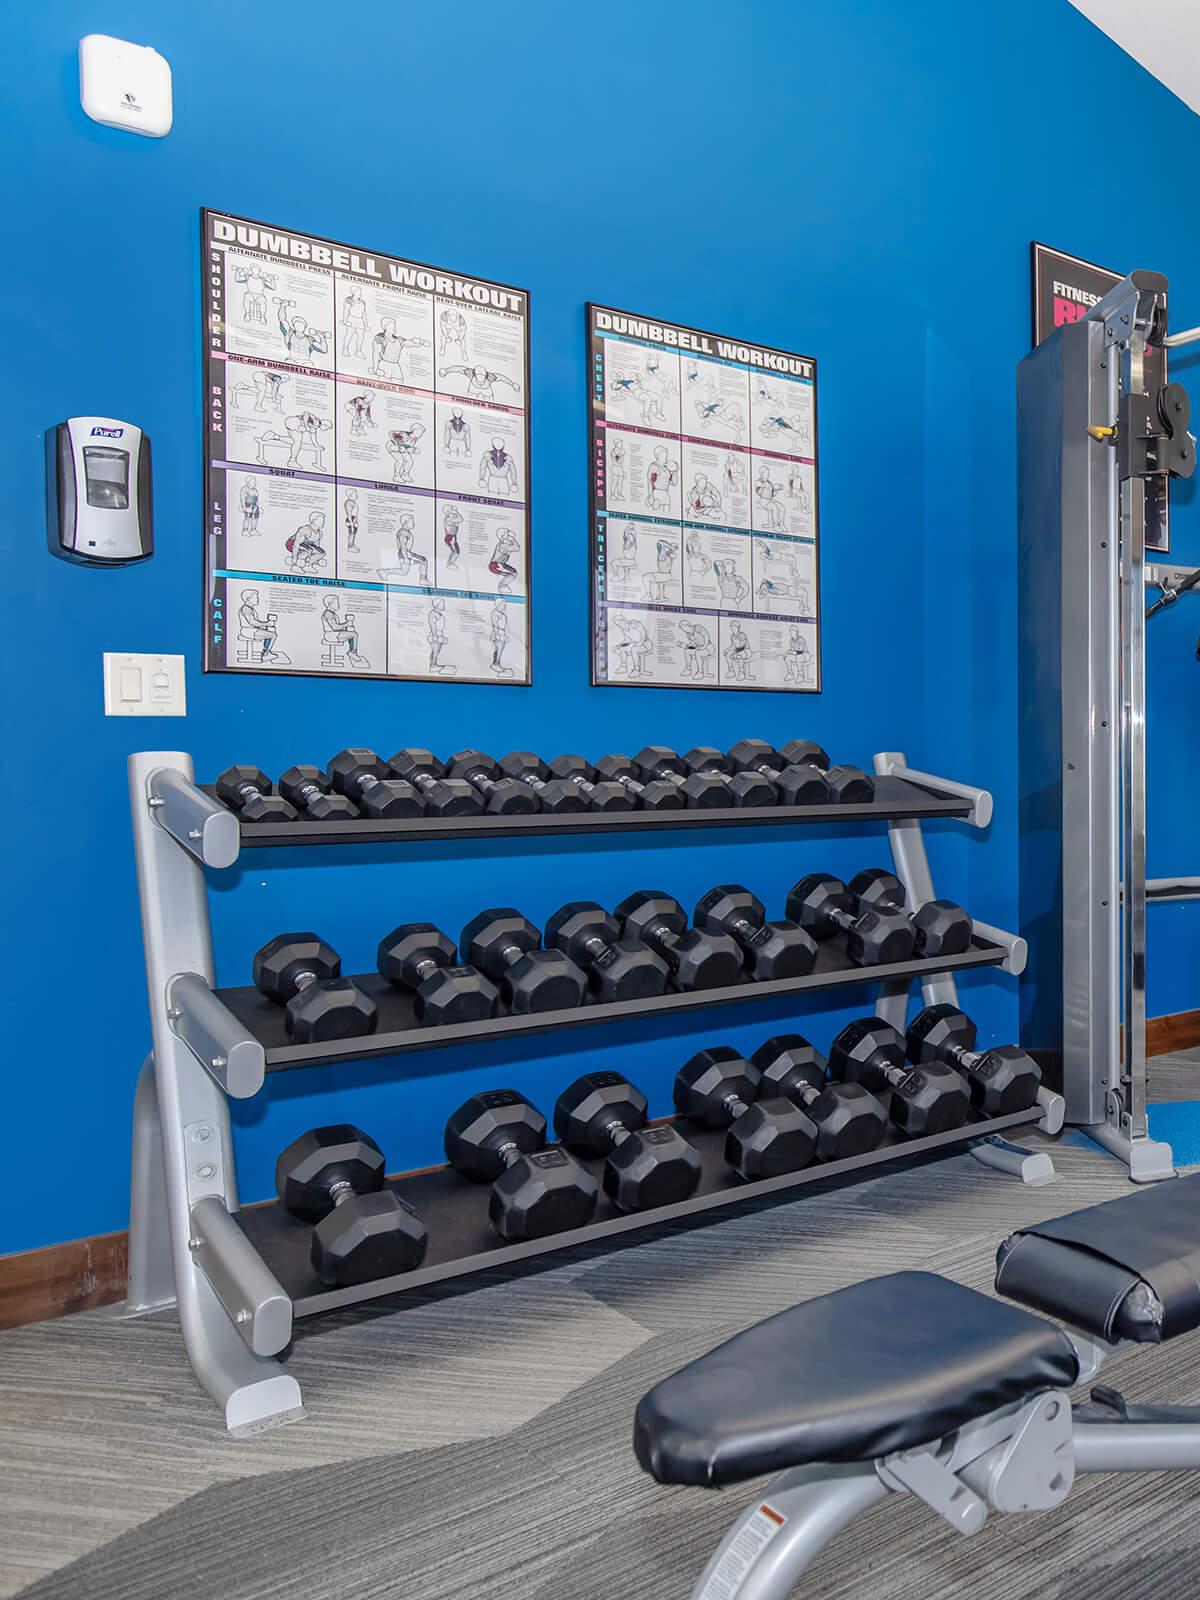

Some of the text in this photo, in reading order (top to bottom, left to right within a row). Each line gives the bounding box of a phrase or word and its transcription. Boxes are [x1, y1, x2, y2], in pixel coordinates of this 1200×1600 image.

[213, 219, 382, 278] DUMBBELL
[388, 263, 523, 312] WORKOUT
[228, 246, 331, 275] ALTERNATE DUMBBELL PRESS
[211, 252, 222, 347] SHOULDER
[341, 273, 427, 299] ALTERNATE FRONT RAISE
[435, 295, 472, 310] BENT-OVER
[474, 304, 501, 317] LATERAL
[503, 310, 522, 321] RAISE
[596, 311, 812, 378] DUMBBELL WORKOUT
[228, 355, 331, 379] ONE-ARM DUMBBELL RAISE
[595, 354, 603, 401] CHEST
[212, 386, 222, 432] BACK
[269, 468, 296, 478] SQUAT
[457, 495, 505, 506] FRONT SQUAT
[213, 501, 222, 535] LEG
[597, 524, 605, 592] TRICEPS
[272, 575, 303, 584] SEATED
[323, 579, 346, 587] RAISE
[213, 598, 223, 645] CALF
